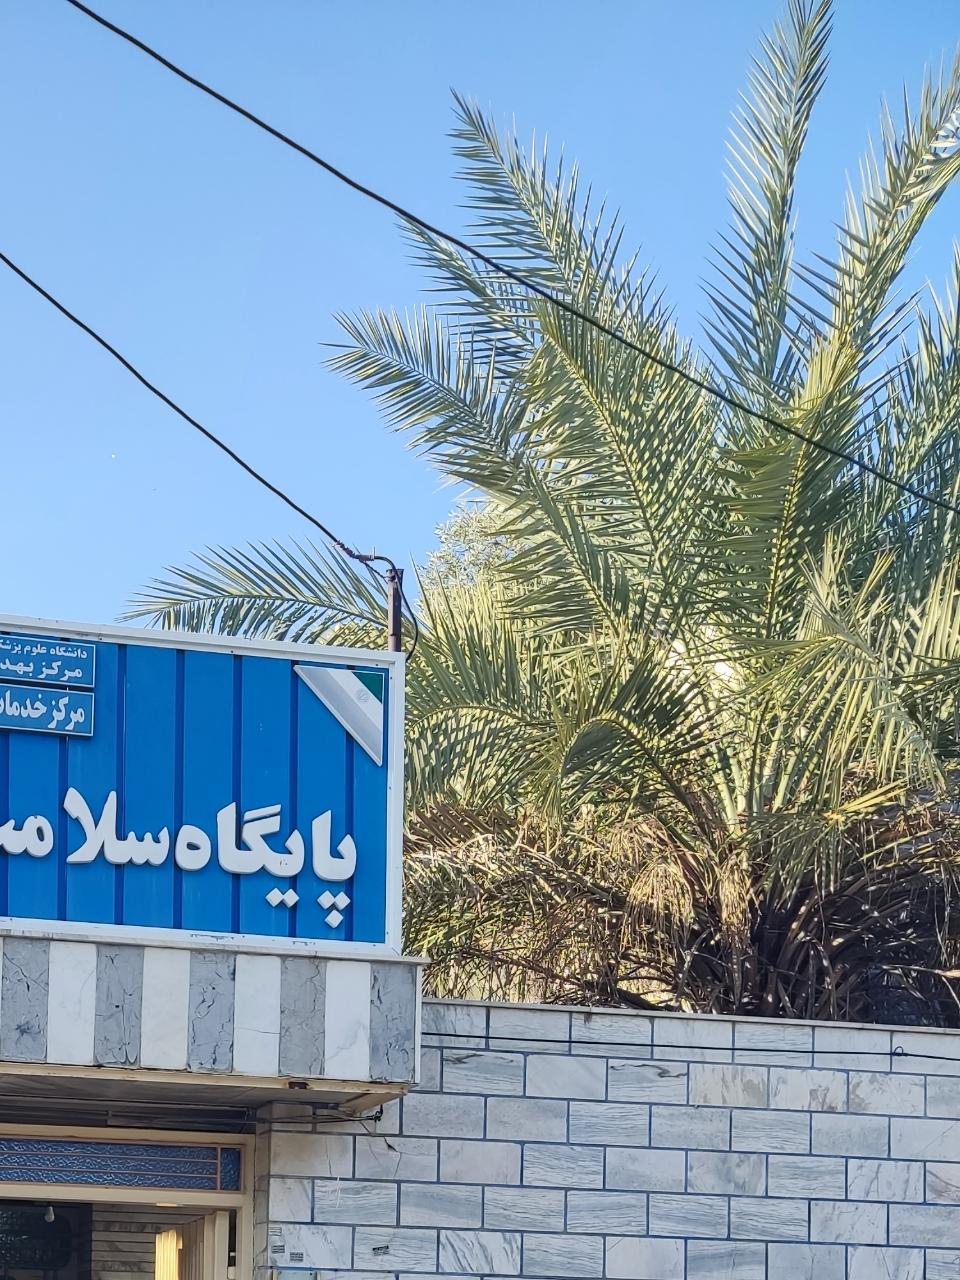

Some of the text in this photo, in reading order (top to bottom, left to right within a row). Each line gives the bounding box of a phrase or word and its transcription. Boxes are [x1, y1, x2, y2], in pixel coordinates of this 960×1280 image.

[24, 643, 47, 656] علوم
[50, 646, 87, 658] دانشگاه
[37, 660, 83, 681] مرکز
[48, 696, 86, 731] مرکز
[174, 801, 358, 929] پایگاه
